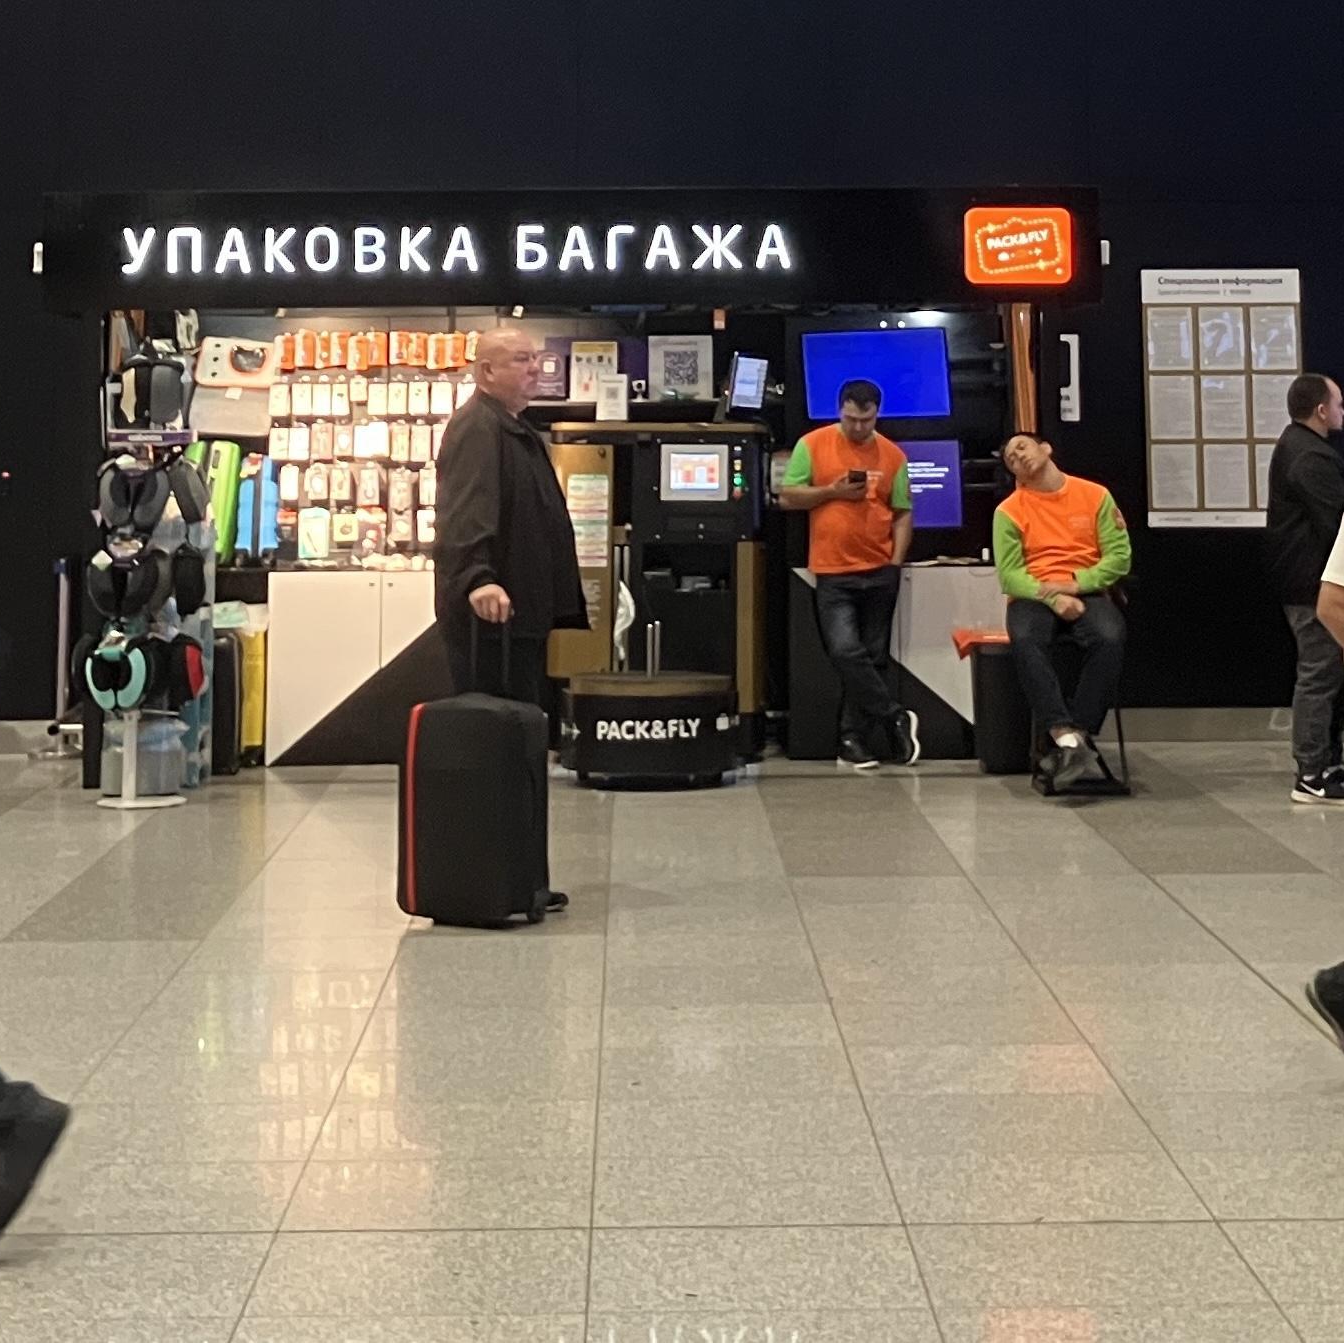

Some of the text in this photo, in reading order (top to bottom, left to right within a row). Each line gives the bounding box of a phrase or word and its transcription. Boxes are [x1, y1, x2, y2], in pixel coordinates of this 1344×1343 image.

[121, 223, 792, 275] УПАКОВКА БАГАЖА
[986, 229, 1050, 251] PACK&FLY
[596, 717, 701, 741] PACK&FLY
